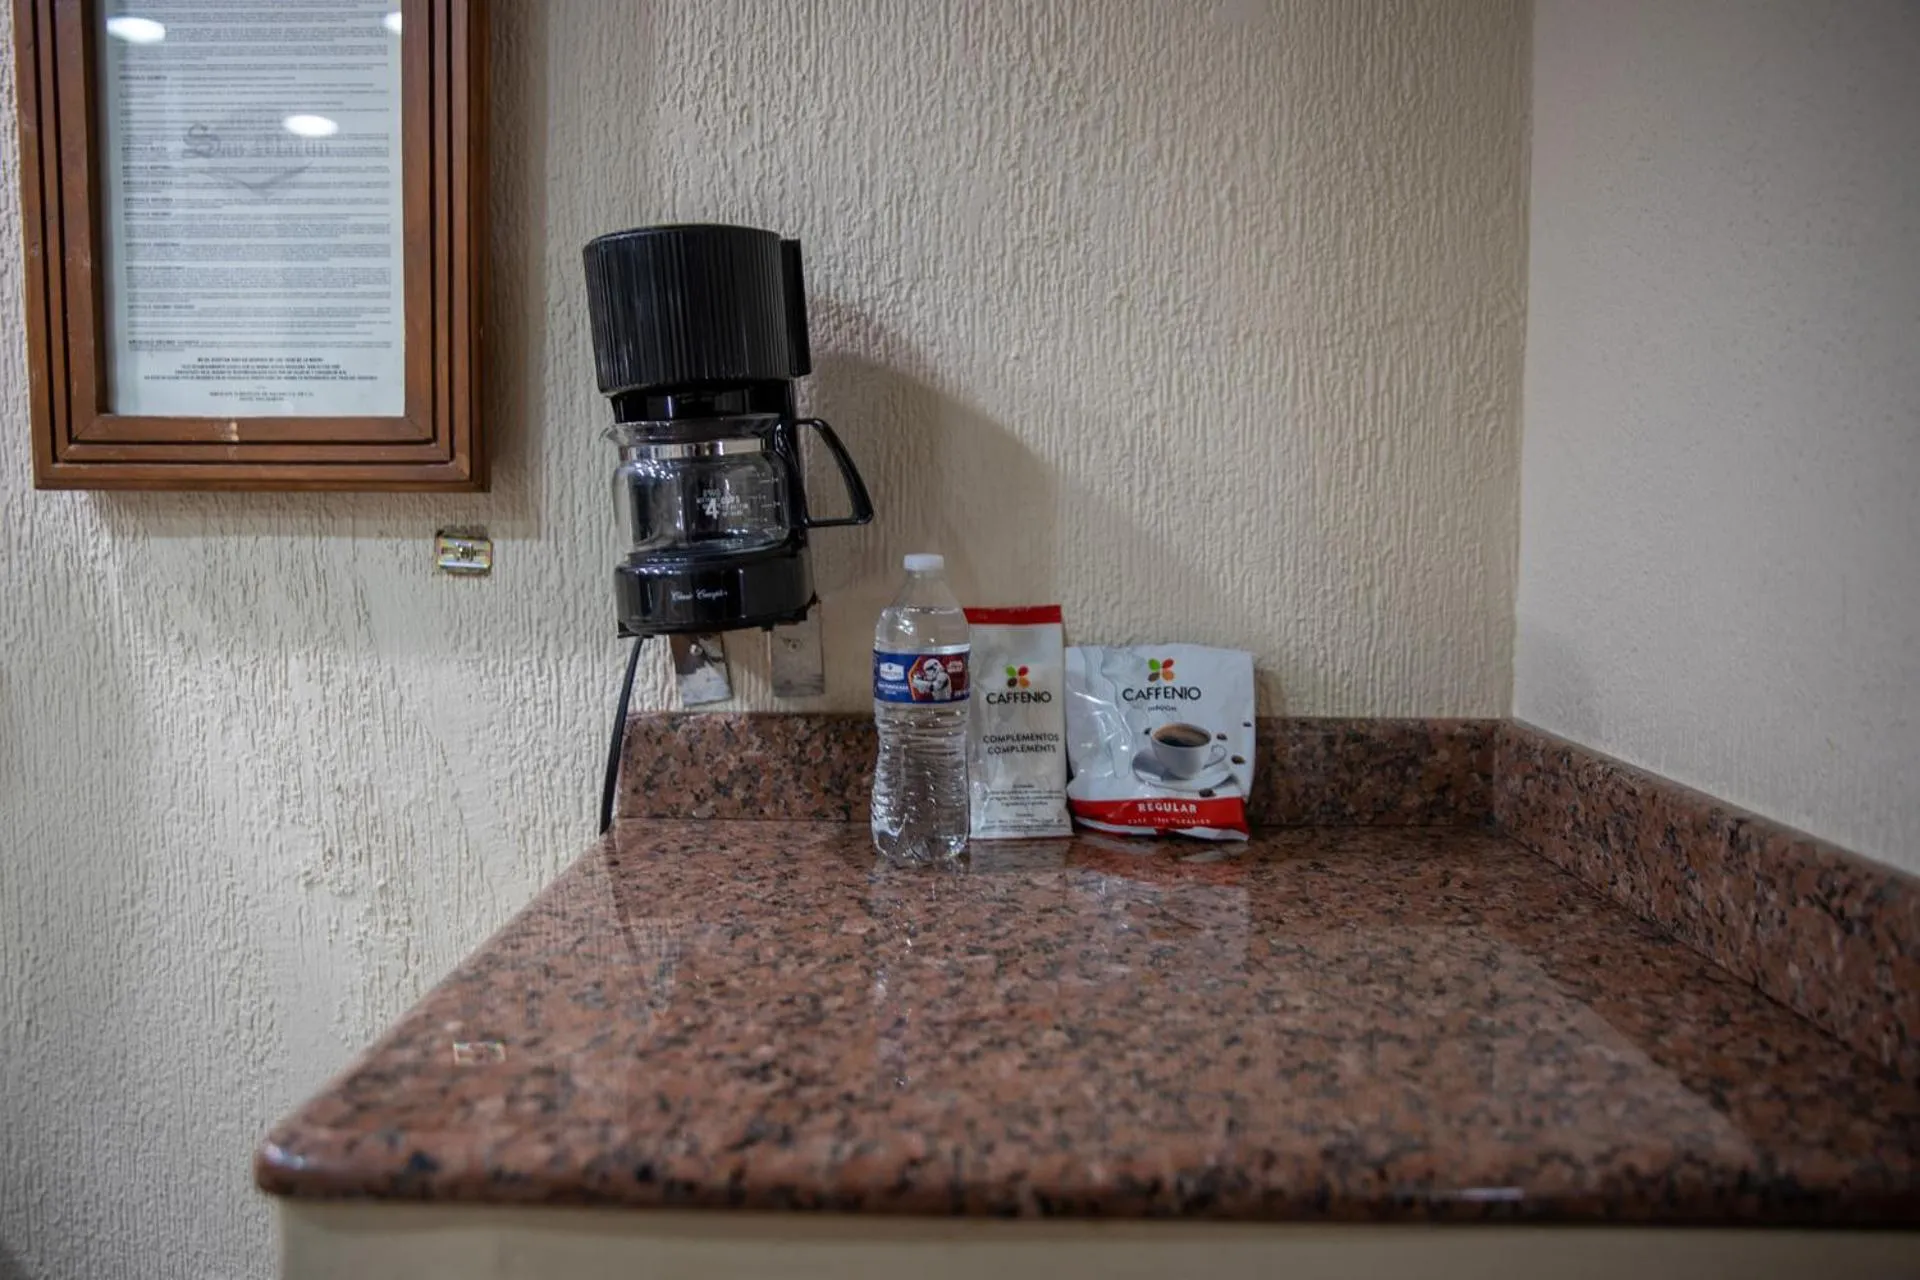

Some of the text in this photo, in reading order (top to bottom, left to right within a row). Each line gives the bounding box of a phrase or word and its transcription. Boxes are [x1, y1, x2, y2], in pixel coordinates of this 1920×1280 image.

[986, 690, 1052, 705] CAFFENIO
[1122, 686, 1202, 701] CAFFENIO
[982, 732, 1060, 744] COMPLEMENTOS
[987, 744, 1057, 755] COMPLEMENTS
[1137, 802, 1198, 813] REGULAR
